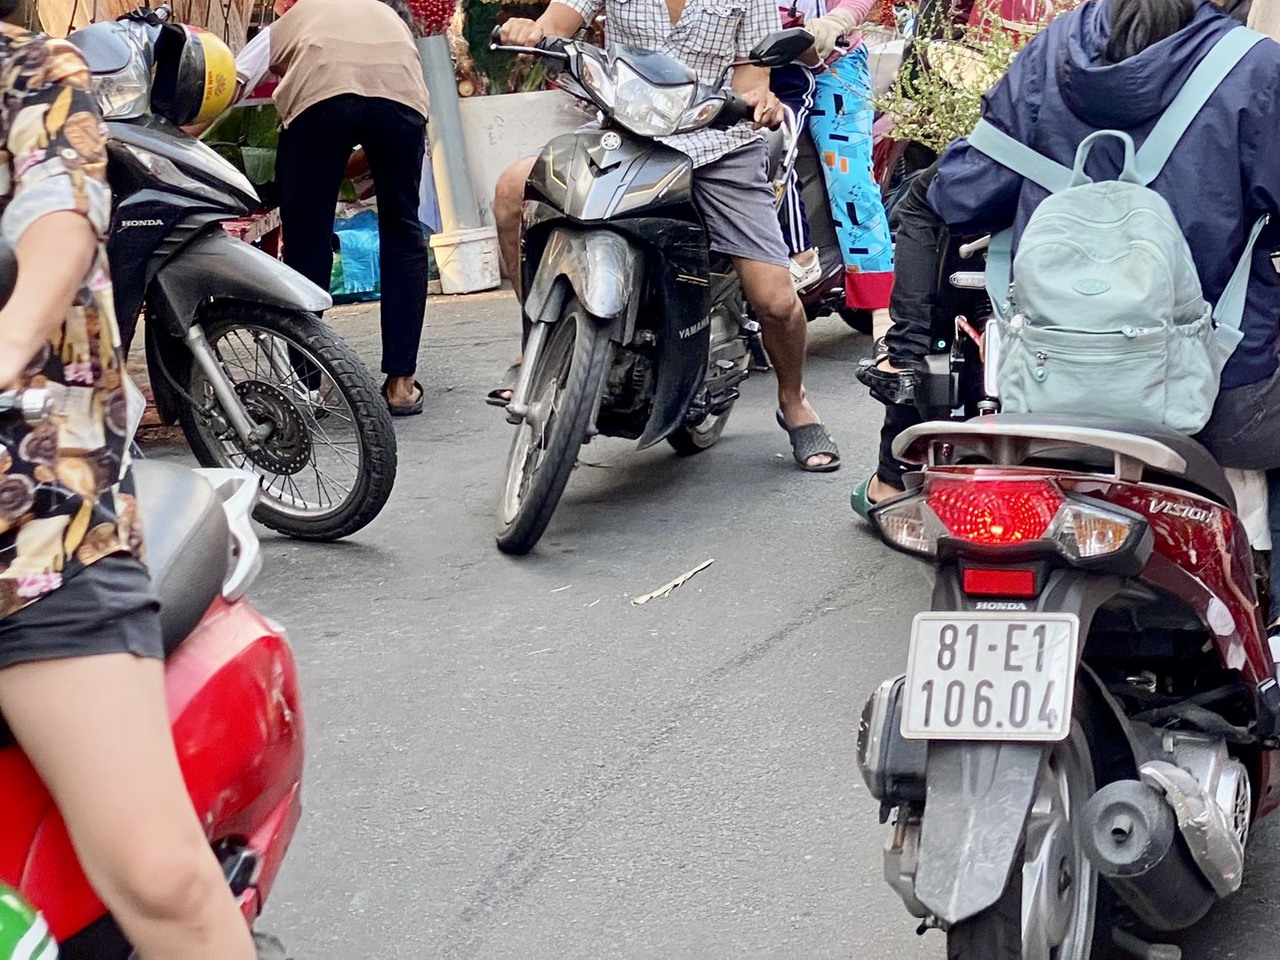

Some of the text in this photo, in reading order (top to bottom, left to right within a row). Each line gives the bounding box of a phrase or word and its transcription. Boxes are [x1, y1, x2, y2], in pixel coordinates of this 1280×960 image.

[121, 219, 165, 227] HONDA
[1149, 497, 1214, 523] VISION
[975, 602, 1028, 610] HONDA
[937, 623, 1047, 672] 81-E1
[921, 678, 1059, 729] 106.04
